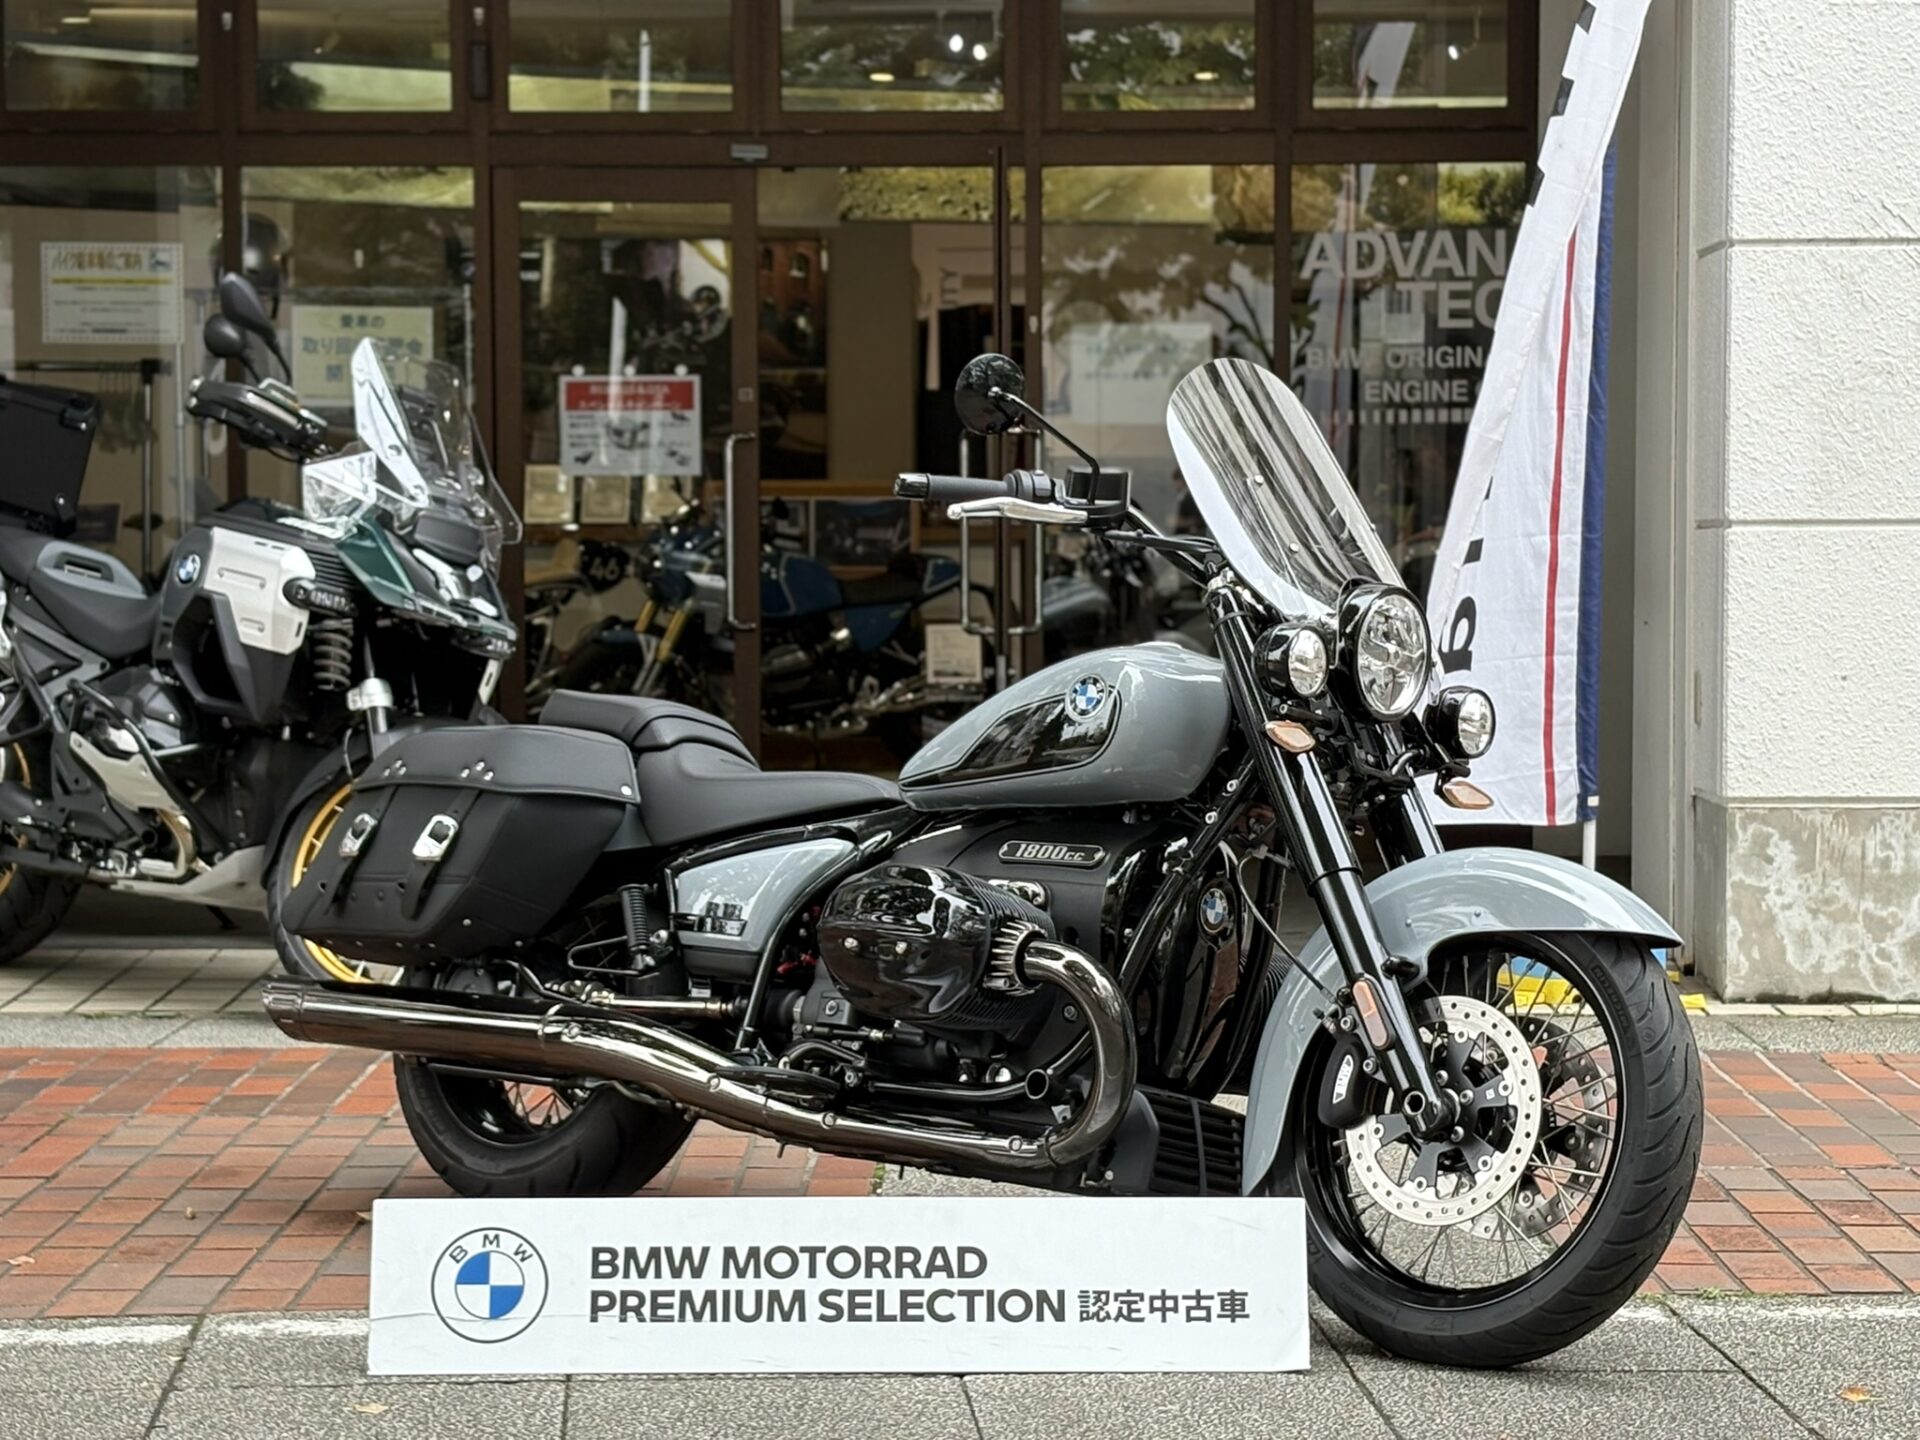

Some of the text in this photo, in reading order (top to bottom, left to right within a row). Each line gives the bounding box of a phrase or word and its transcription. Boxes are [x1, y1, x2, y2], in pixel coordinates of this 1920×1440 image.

[1300, 229, 1507, 280] ADVAN
[1386, 345, 1487, 370] ORIGIN
[1364, 379, 1469, 404] ENGINE
[590, 556, 620, 581] 46
[1015, 843, 1086, 861] 1800cc
[449, 1233, 533, 1264] BMW
[591, 1245, 988, 1279] BMW MOTORRAD
[589, 1288, 1250, 1323] PREMIUM SELECTION 認定中古車
